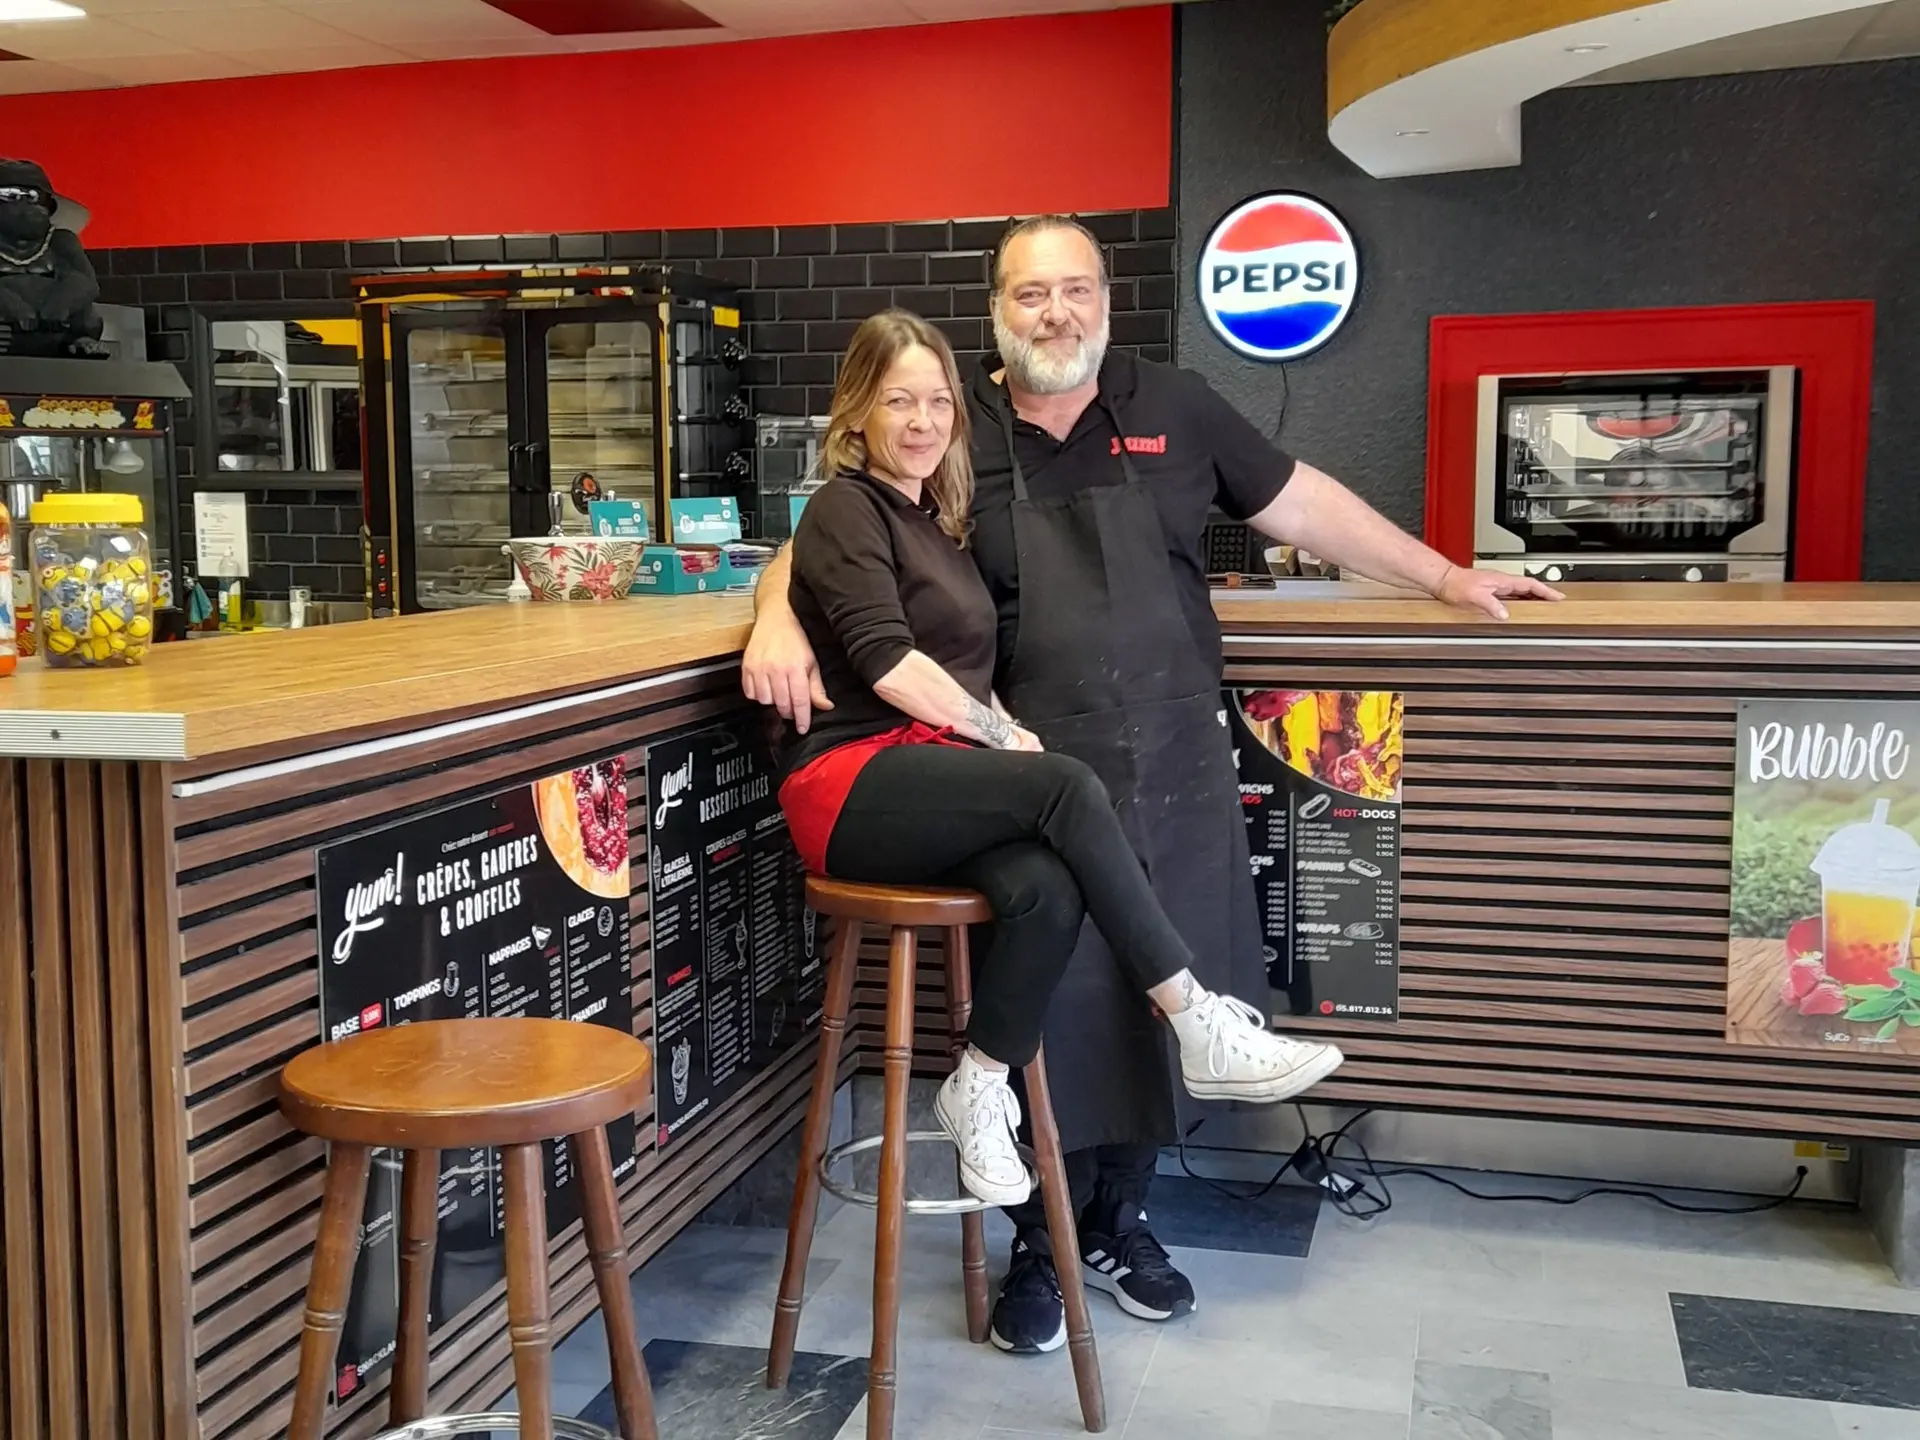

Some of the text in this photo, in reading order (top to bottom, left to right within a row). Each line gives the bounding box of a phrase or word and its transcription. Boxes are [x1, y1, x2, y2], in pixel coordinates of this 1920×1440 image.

[1213, 260, 1346, 293] PEPSI
[700, 773, 769, 823] DESSERTS GLACÉS
[1333, 808, 1396, 819] HOT-DOGS
[417, 834, 538, 906] CRÊPES, GAUFRES
[441, 878, 520, 936] & CROFFLES
[568, 906, 595, 928] GLACES
[1296, 922, 1341, 934] WRAPS
[489, 936, 532, 966] NAPPAGES
[394, 978, 441, 1010] TOPPINGS
[331, 1015, 360, 1040] BASE
